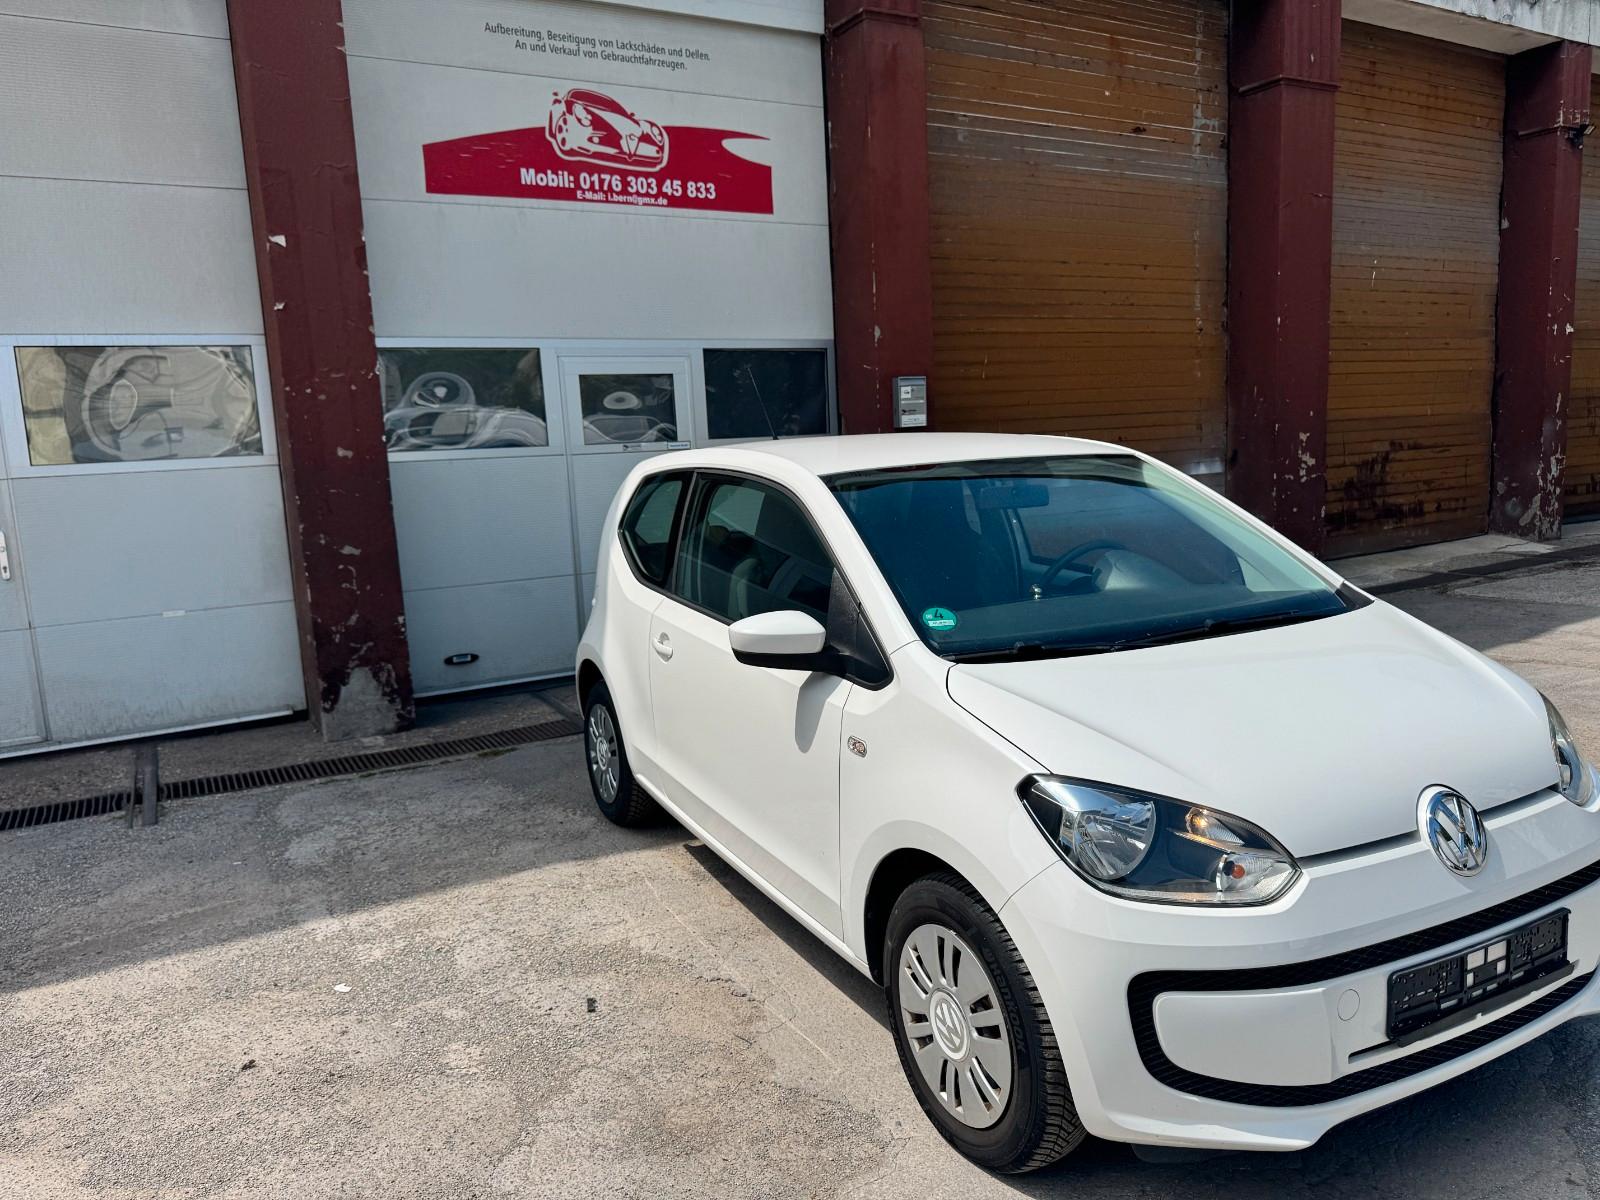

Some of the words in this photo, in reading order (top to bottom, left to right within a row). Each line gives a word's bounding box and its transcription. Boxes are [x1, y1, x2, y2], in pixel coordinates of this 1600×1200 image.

[485, 21, 544, 42] Aufbereitung,
[547, 30, 596, 48] Beseitigung
[598, 39, 613, 48] von
[616, 40, 666, 55] Lackschäden
[668, 47, 683, 57] und
[515, 39, 527, 49] An
[530, 43, 546, 53] und
[549, 44, 580, 56] Verkauf
[583, 50, 598, 59] von
[600, 50, 688, 71] Gebrauchtfahrzeugen.
[520, 167, 575, 189] Mobil:
[580, 172, 622, 192] 0176
[627, 176, 658, 195] 303
[662, 179, 683, 197] 45
[687, 182, 716, 200] 833
[577, 191, 606, 201] E-Mail:
[934, 608, 944, 619] 4
